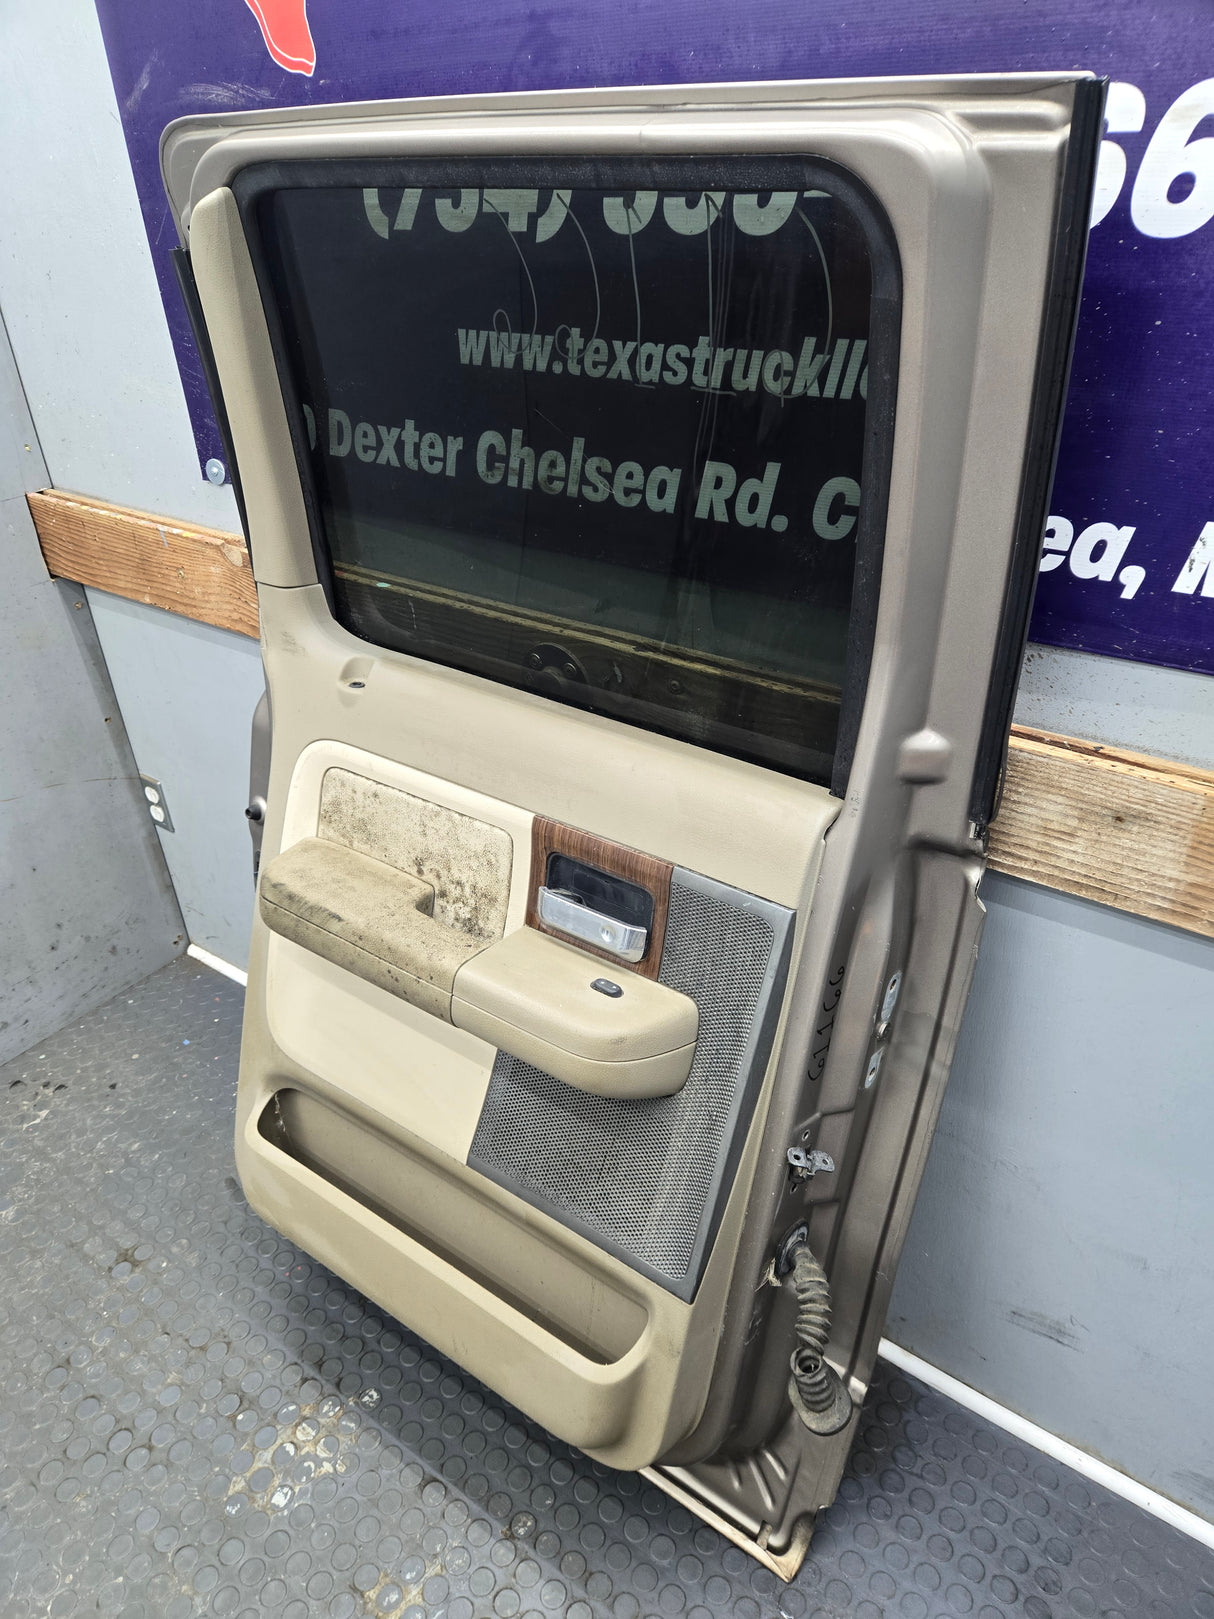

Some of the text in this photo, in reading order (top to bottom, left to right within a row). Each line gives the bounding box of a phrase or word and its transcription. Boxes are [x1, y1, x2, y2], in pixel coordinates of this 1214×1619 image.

[457, 326, 868, 400] www.texastruckll
[328, 408, 464, 477] Dexter
[476, 428, 683, 514] Chelsea
[694, 460, 789, 533] Rd.
[812, 476, 862, 543] C
